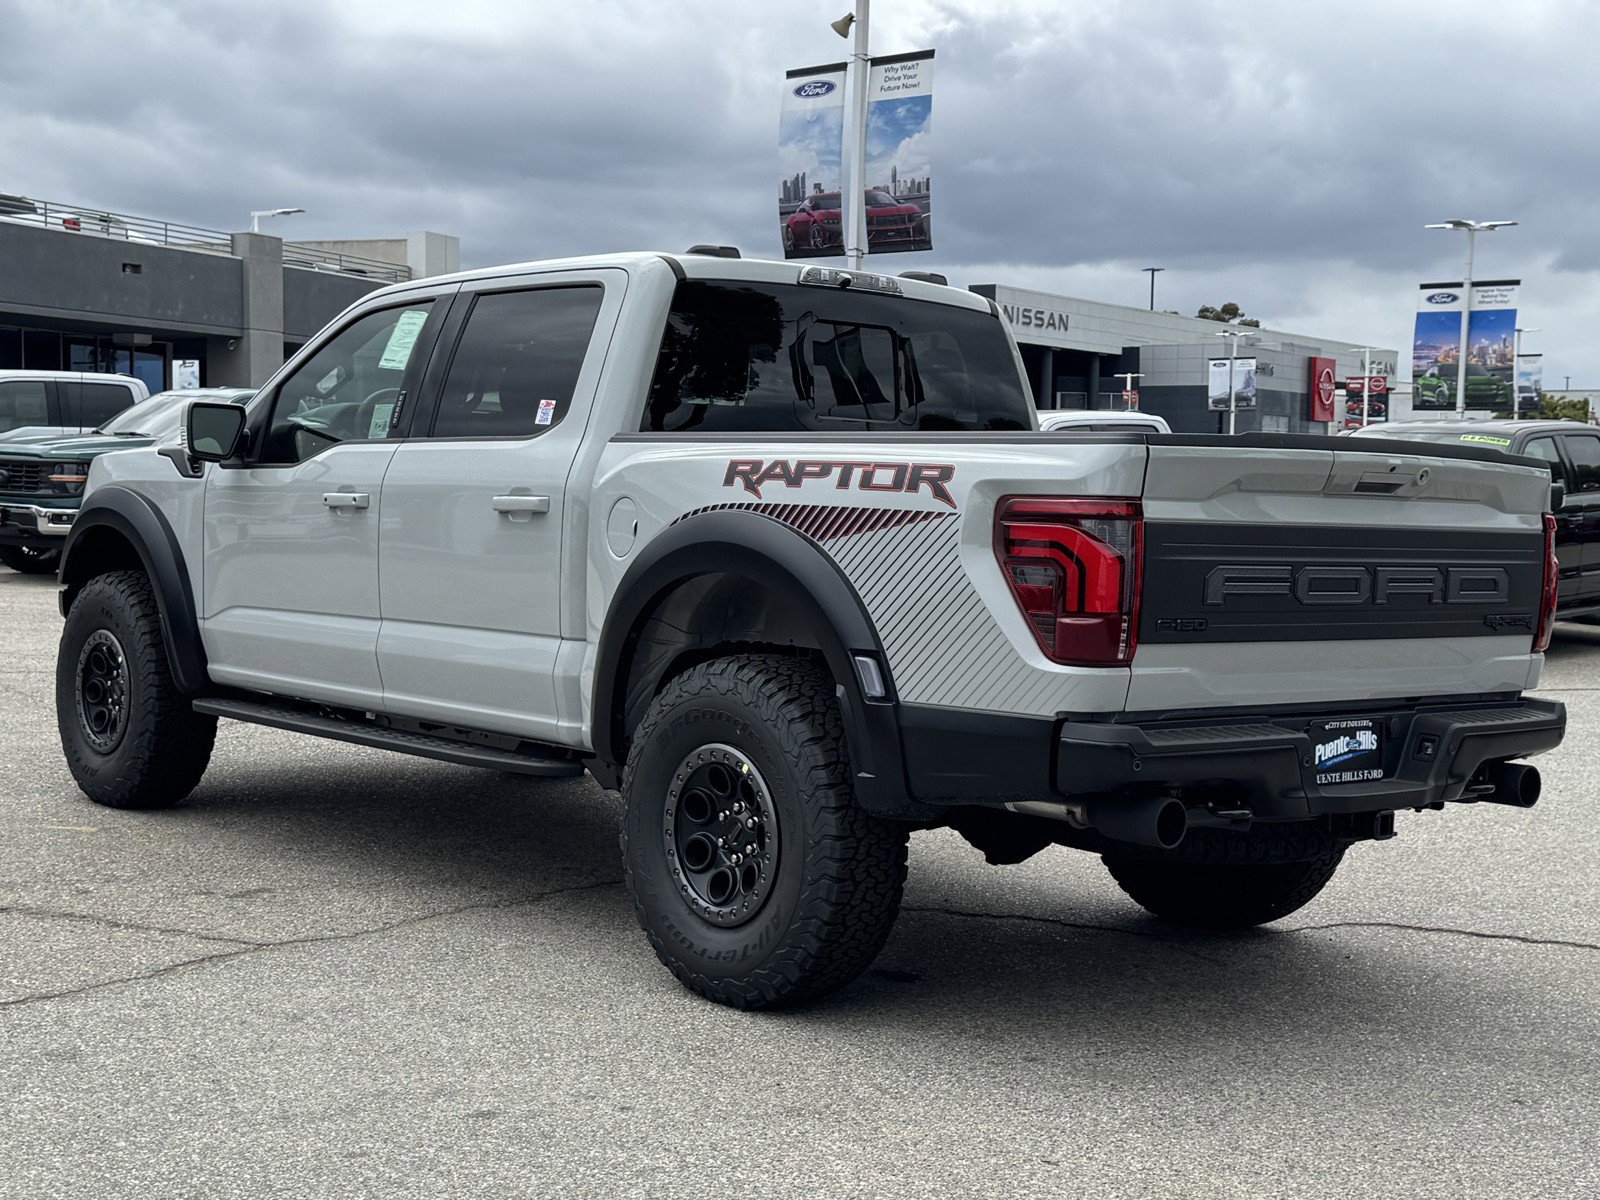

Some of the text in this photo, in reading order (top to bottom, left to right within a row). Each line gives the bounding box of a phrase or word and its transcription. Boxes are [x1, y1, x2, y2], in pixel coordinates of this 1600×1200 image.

[884, 63, 919, 74] Why Wait?
[902, 81, 920, 90] Now!
[1003, 304, 1069, 332] NISSAN
[1360, 358, 1396, 376] NSSAN
[722, 459, 958, 509] RAPTOR
[1202, 565, 1510, 606] FORD
[1315, 735, 1350, 765] Puente
[1356, 730, 1377, 750] Hills
[1317, 769, 1384, 784] UENTE HILLS FORD
